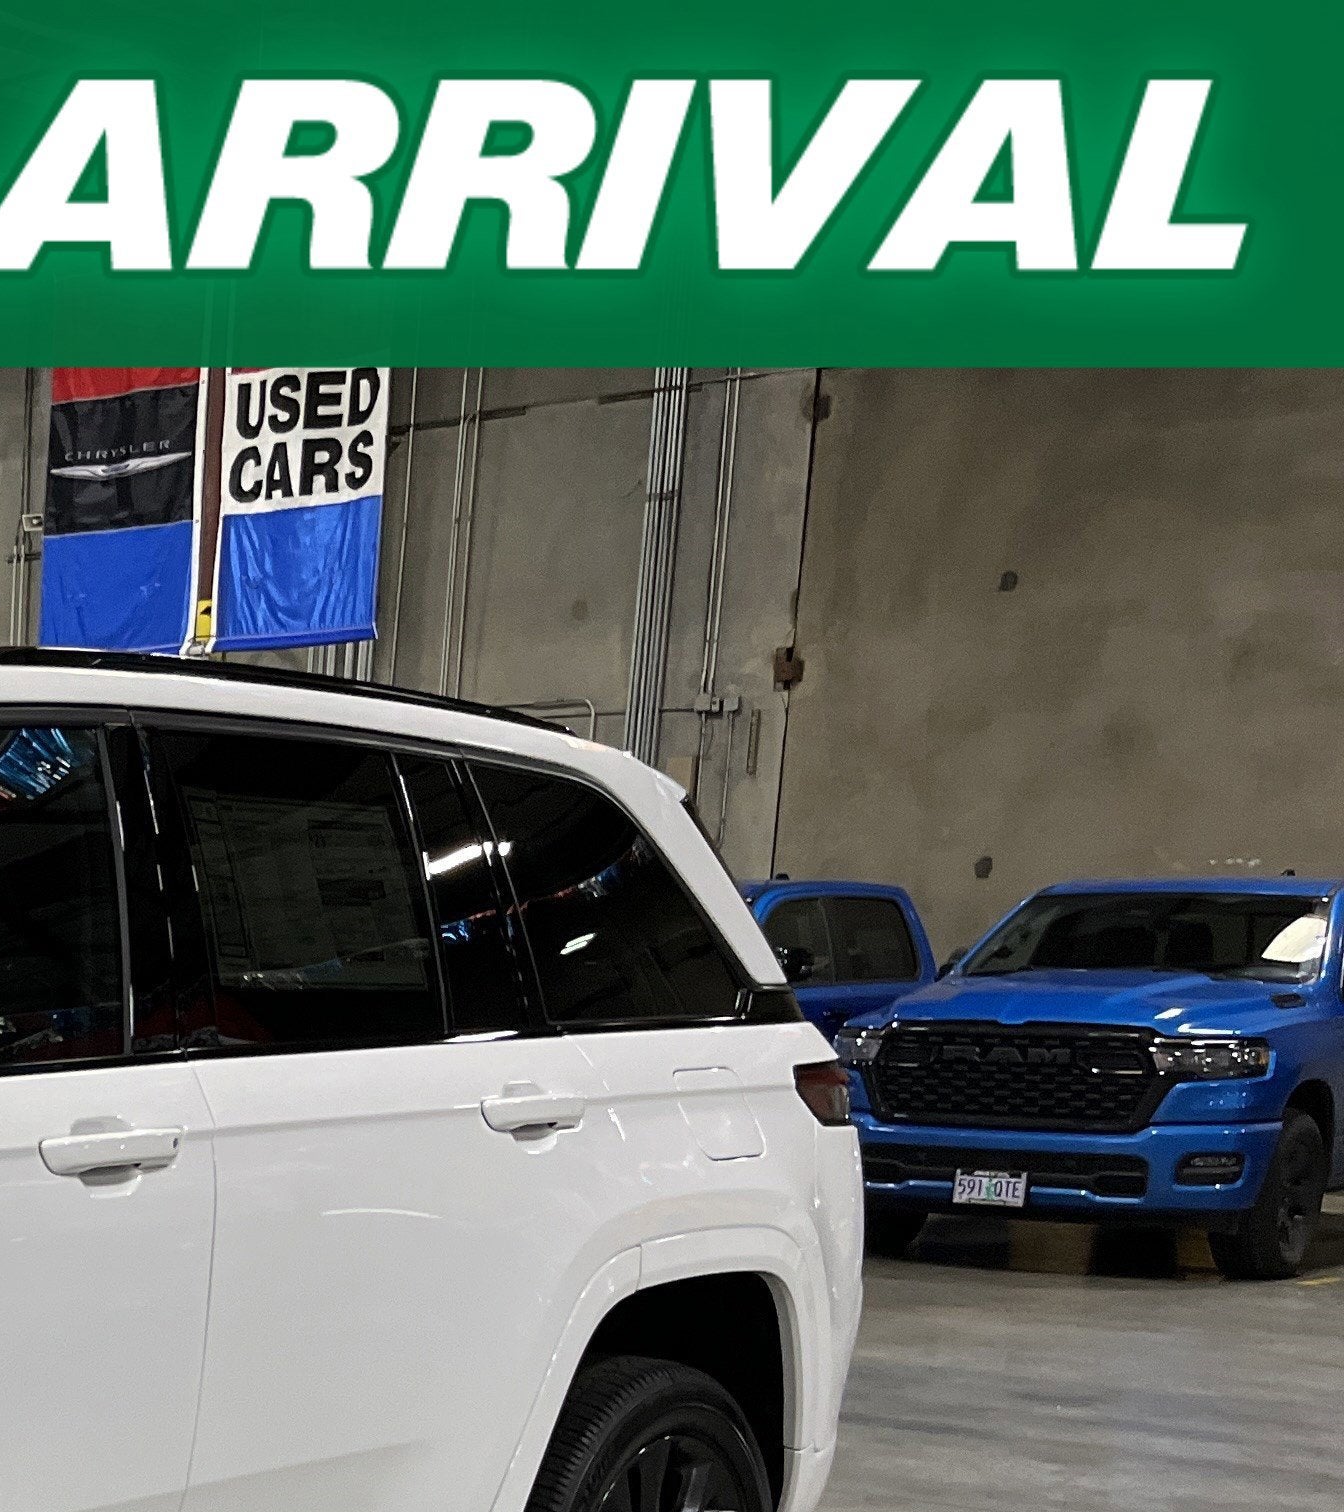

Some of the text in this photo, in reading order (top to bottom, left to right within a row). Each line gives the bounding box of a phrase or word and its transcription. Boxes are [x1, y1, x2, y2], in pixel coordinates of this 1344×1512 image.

[235, 367, 381, 440] USED
[64, 438, 172, 462] CHRYSLER
[229, 430, 374, 503] CARS
[941, 1044, 1072, 1064] RAM
[957, 1177, 983, 1197] 591
